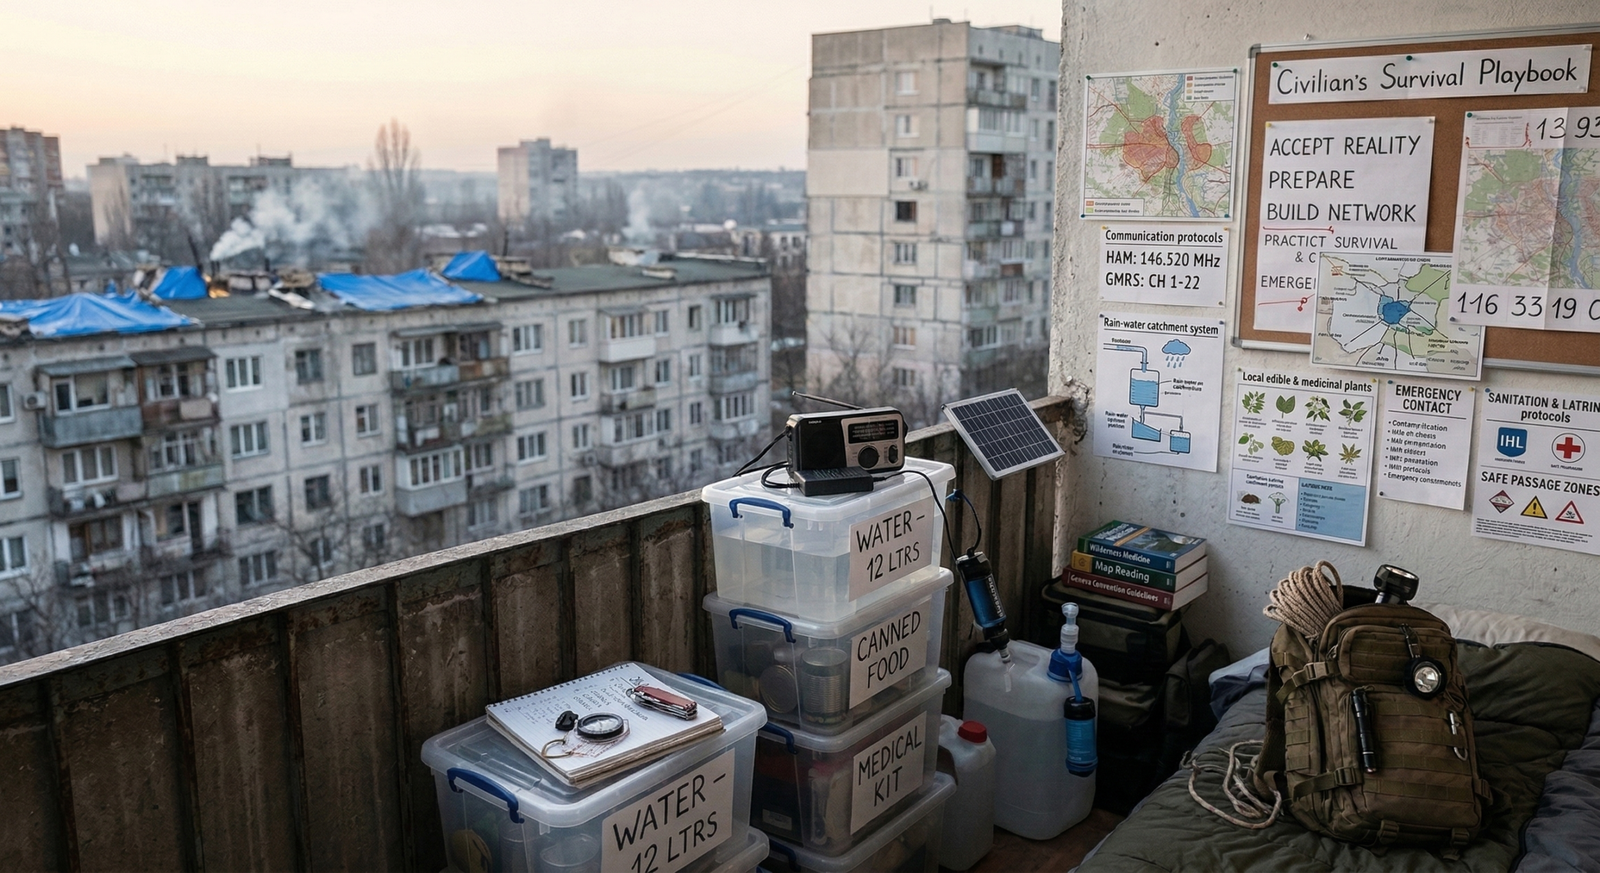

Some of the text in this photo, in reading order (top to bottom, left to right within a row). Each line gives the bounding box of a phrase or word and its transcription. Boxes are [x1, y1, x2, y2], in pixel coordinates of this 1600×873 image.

[1277, 57, 1578, 95] Civilian's Survival Playbook
[1536, 117, 1567, 140] 13
[1269, 135, 1421, 157] ACCEPT REALITY
[1269, 170, 1356, 189] PREPARE
[1267, 202, 1417, 223] BUILD NETWORK
[1105, 229, 1224, 245] Communication protocols
[1334, 236, 1398, 250] SURVIVAL
[1106, 250, 1221, 268] HAM: 146.520 MHz
[1294, 252, 1304, 264] &
[1105, 271, 1200, 290] GMRS: CH 1-22
[1511, 295, 1543, 317] 33
[1552, 297, 1577, 319] 19
[1103, 317, 1219, 336] Rain-water catchment system
[1242, 371, 1373, 393] Local edible & medicinal plants
[1395, 384, 1462, 402] EMERGENCY
[1402, 398, 1453, 414] CONTACT
[1487, 392, 1549, 408] SANITATION
[1551, 397, 1560, 409] &
[1520, 410, 1571, 423] protocols
[1500, 434, 1524, 449] IHL
[1481, 471, 1509, 485] SAFE
[1511, 474, 1561, 492] PASSAGE
[1563, 481, 1600, 497] ZONES
[856, 510, 913, 553] WATER
[867, 541, 920, 582] 12 LTRS
[1090, 543, 1151, 565] Wilderness Medicine
[1095, 560, 1150, 584] Map Reading
[1070, 574, 1091, 586] Geneva
[1092, 580, 1126, 595] Convention
[857, 610, 921, 662] CANNED
[867, 646, 909, 689] FOOD
[858, 725, 922, 786] MEDICAL
[874, 765, 903, 807] KIT
[613, 774, 706, 851] WATER
[631, 811, 718, 873] 12 LTRS
